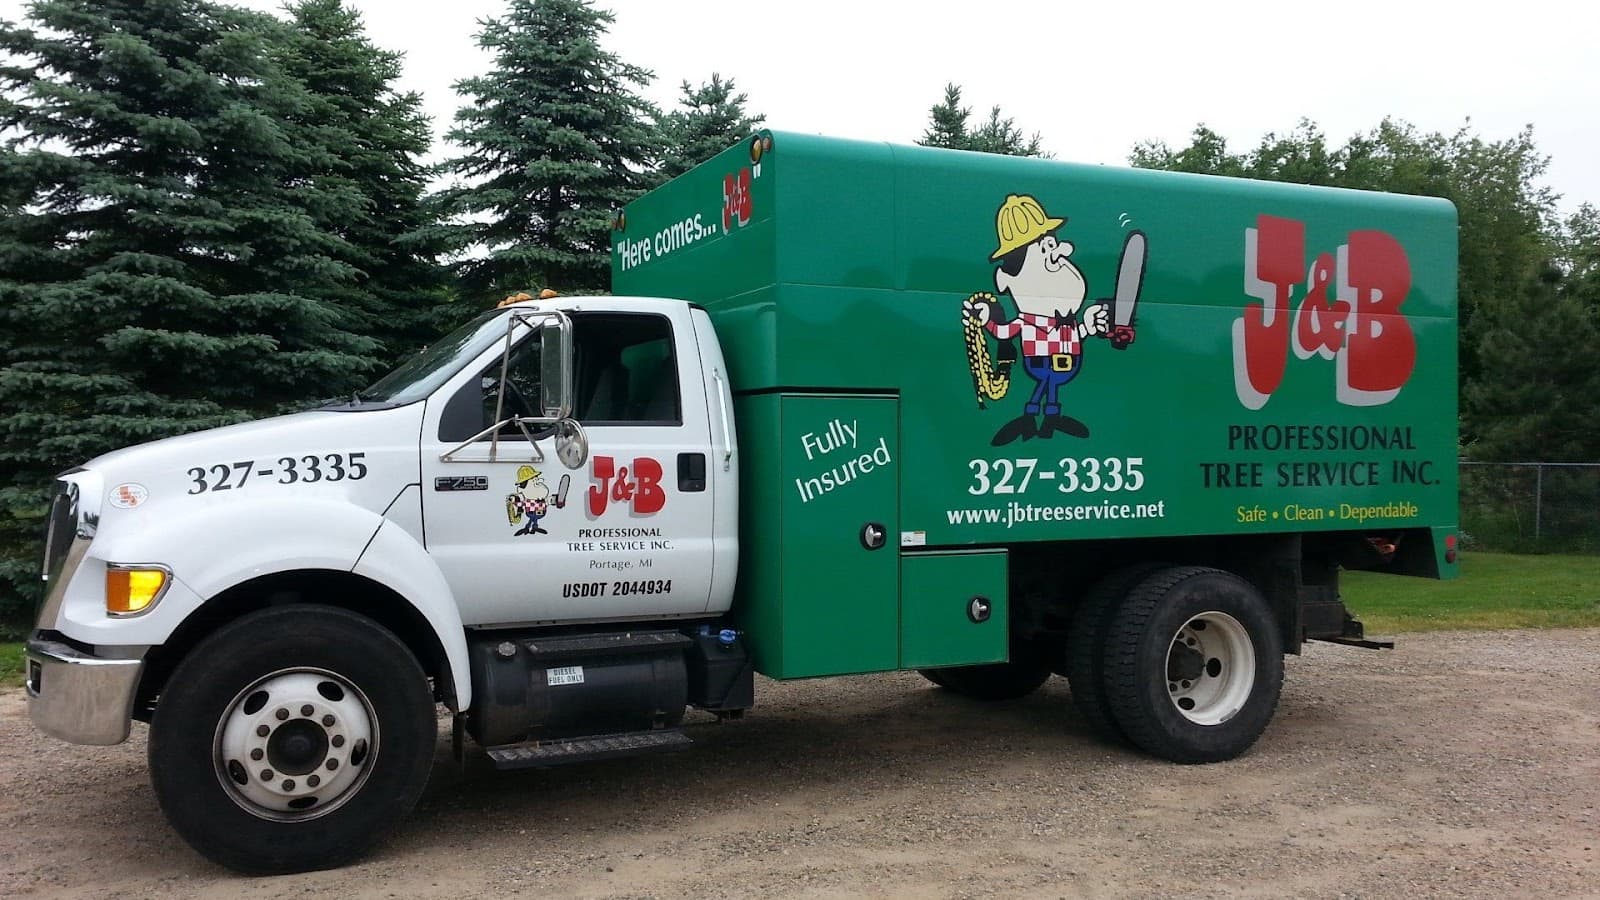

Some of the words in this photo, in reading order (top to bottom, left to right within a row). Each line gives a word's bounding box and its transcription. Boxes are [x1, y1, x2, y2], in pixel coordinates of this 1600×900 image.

[617, 238, 651, 271] "Here
[655, 213, 717, 257] comes...
[1232, 214, 1417, 410] J&B
[801, 419, 857, 461] Fully
[1228, 425, 1416, 450] PROFESSIONAL
[187, 452, 368, 495] 327-3335
[435, 477, 488, 488] F750
[795, 437, 891, 503] Insured
[968, 457, 1145, 496] 327-3335
[1200, 462, 1263, 488] TREE
[1277, 461, 1379, 487] SERVICE
[1392, 460, 1440, 485] INC.
[585, 455, 666, 520] J&B
[946, 499, 1165, 528] www.jbtreeservice.net
[1237, 504, 1267, 523] Safe
[1284, 504, 1324, 521] Clean
[1339, 501, 1418, 523] Dependable
[567, 541, 595, 552] TREE
[599, 540, 646, 551] SERVICE
[650, 540, 675, 550] INC.
[578, 528, 662, 538] PROFESSIONAL
[639, 558, 653, 568] MI
[562, 582, 608, 598] USDOT
[613, 579, 672, 596] 2044934
[548, 676, 566, 685] FUEL
[567, 675, 583, 683] ONLY
[553, 667, 576, 676] DIESEL
